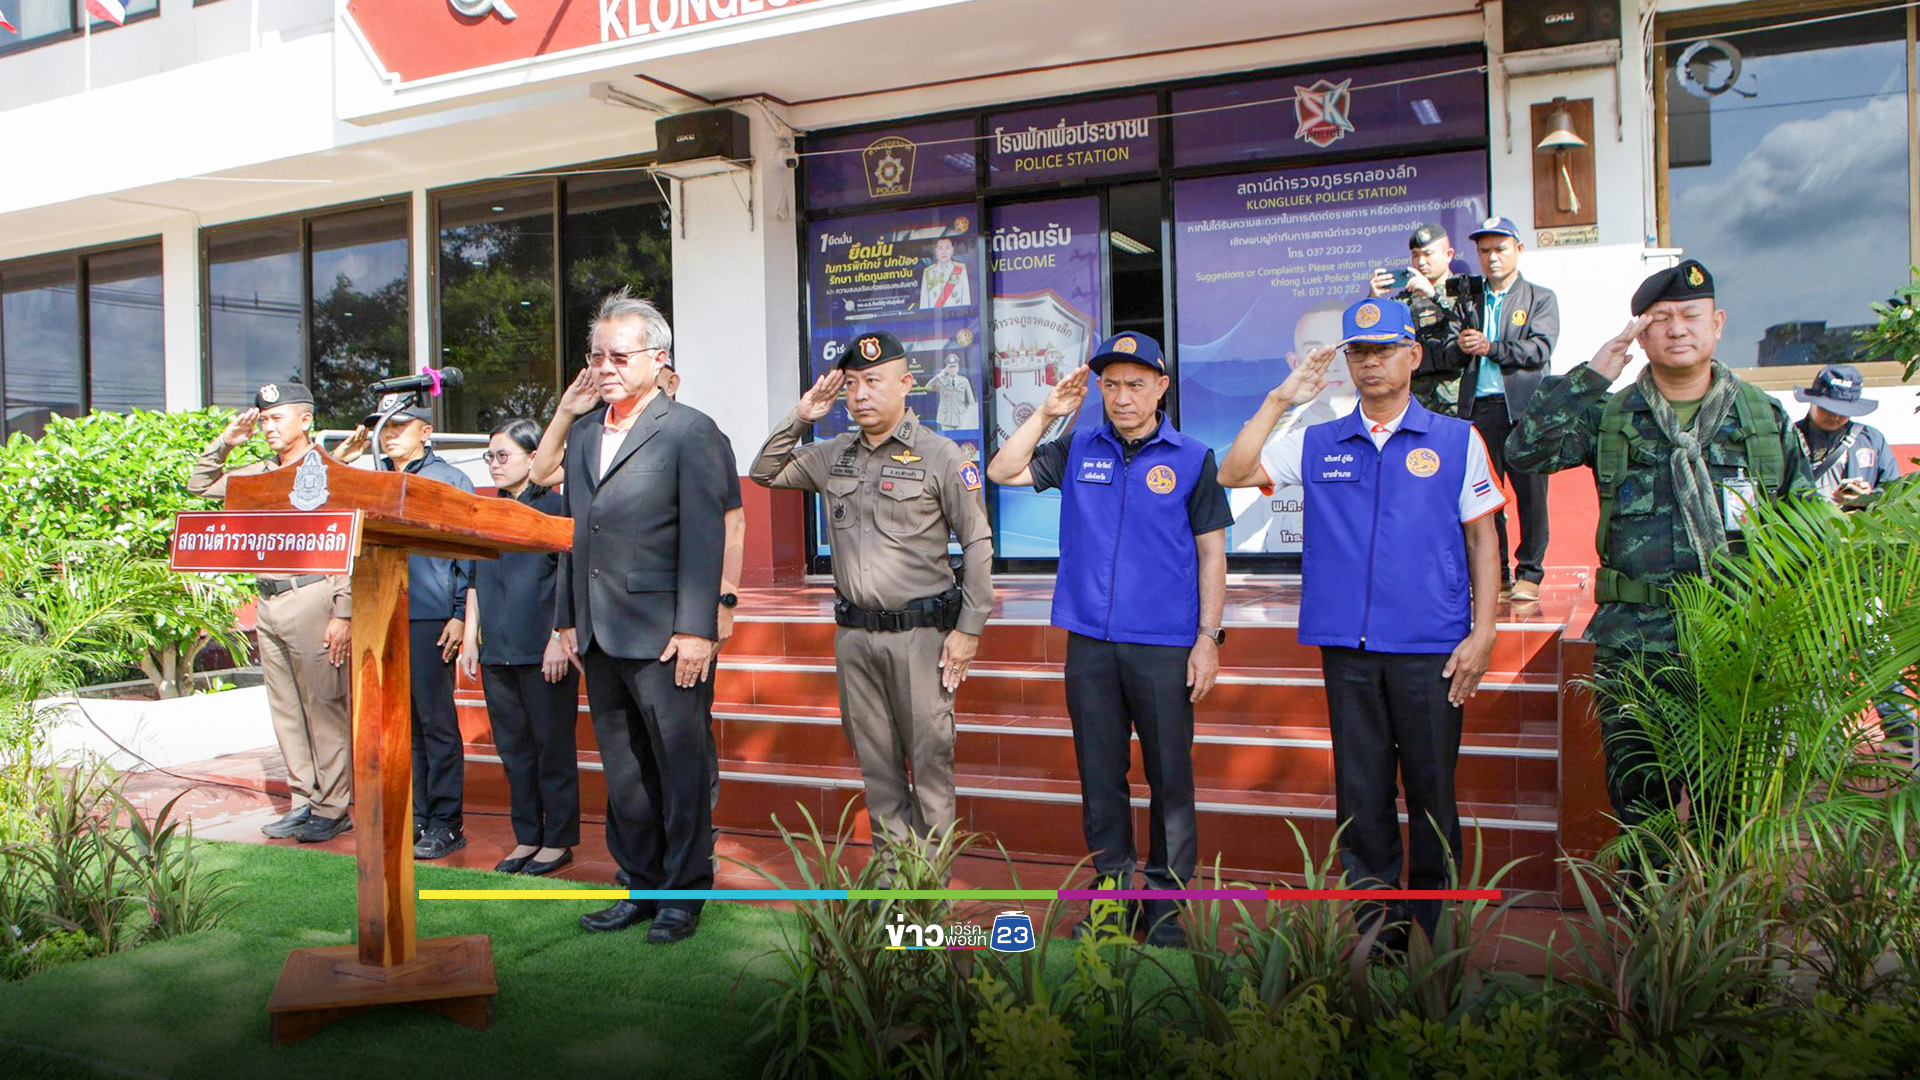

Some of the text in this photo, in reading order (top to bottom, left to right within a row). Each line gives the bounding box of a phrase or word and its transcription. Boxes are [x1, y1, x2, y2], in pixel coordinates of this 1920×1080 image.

[995, 118, 1149, 154] โรงพักเพื่อประชาชน
[1015, 147, 1129, 171] POLICE STATION
[1237, 164, 1417, 195] สถานีตำรวจภูธรคลองลึก
[1246, 185, 1407, 210] KLONGLUEK POLICE STATION
[992, 222, 1072, 252] ดีต้อนรับ
[1306, 248, 1324, 258] 037
[1325, 245, 1344, 256] 230
[1345, 244, 1362, 254] 222
[1195, 270, 1245, 283] Suggestions
[1246, 270, 1256, 278] or
[1308, 262, 1335, 273] Please
[1337, 259, 1366, 271] inform
[1368, 257, 1383, 268] the
[1384, 255, 1412, 268] Superi
[1270, 277, 1301, 288] Khlong
[1302, 275, 1323, 286] Luek
[1324, 273, 1349, 283] Police
[1308, 287, 1326, 297] 037
[1326, 285, 1344, 295] 230
[1345, 283, 1361, 293] 222
[991, 315, 1073, 338] ตำรวจภูธรคลองลึก
[822, 340, 838, 361] 6
[1272, 500, 1304, 513] พ.ต.
[178, 523, 347, 561] สถานีตำรวจภูธรคลองลึก
